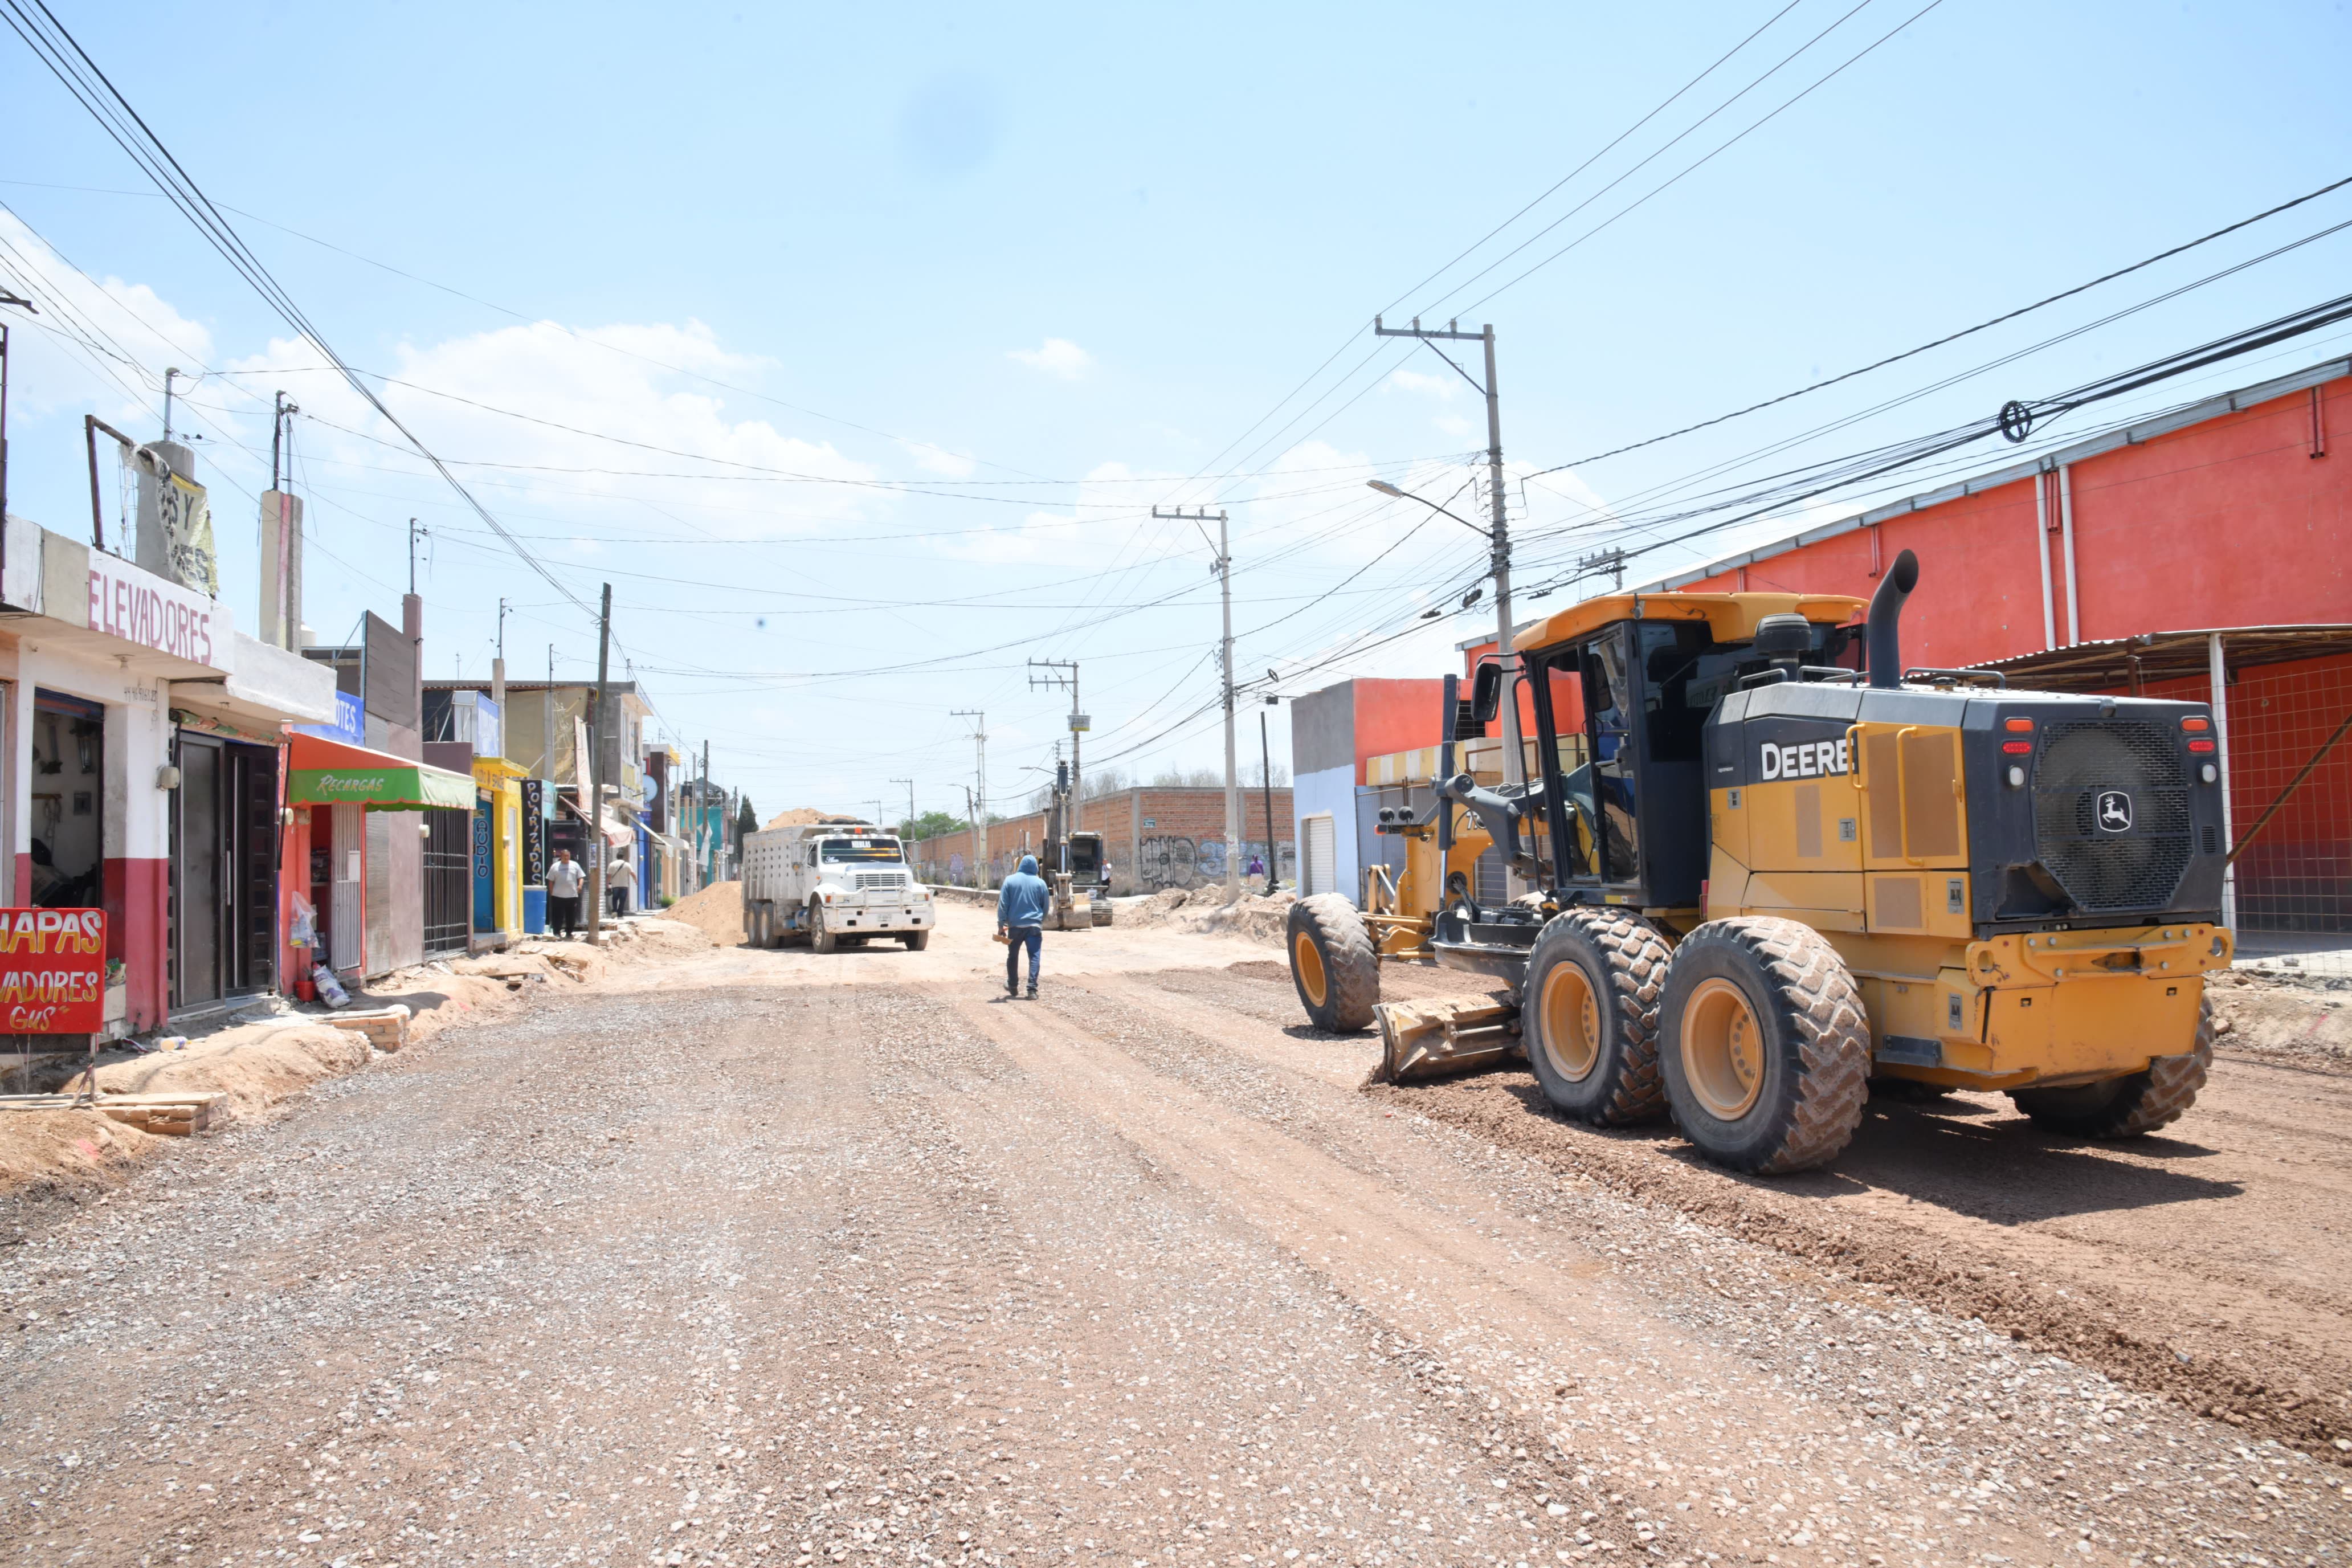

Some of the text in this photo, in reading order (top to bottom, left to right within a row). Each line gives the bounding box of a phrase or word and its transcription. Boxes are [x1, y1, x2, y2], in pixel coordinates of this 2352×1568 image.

[88, 570, 211, 666] ELEVADORES
[316, 775, 385, 795] RECARGAS
[1761, 739, 1855, 780] DEERE
[476, 820, 488, 877] AUDIO
[526, 782, 541, 885] POLARIZADOS
